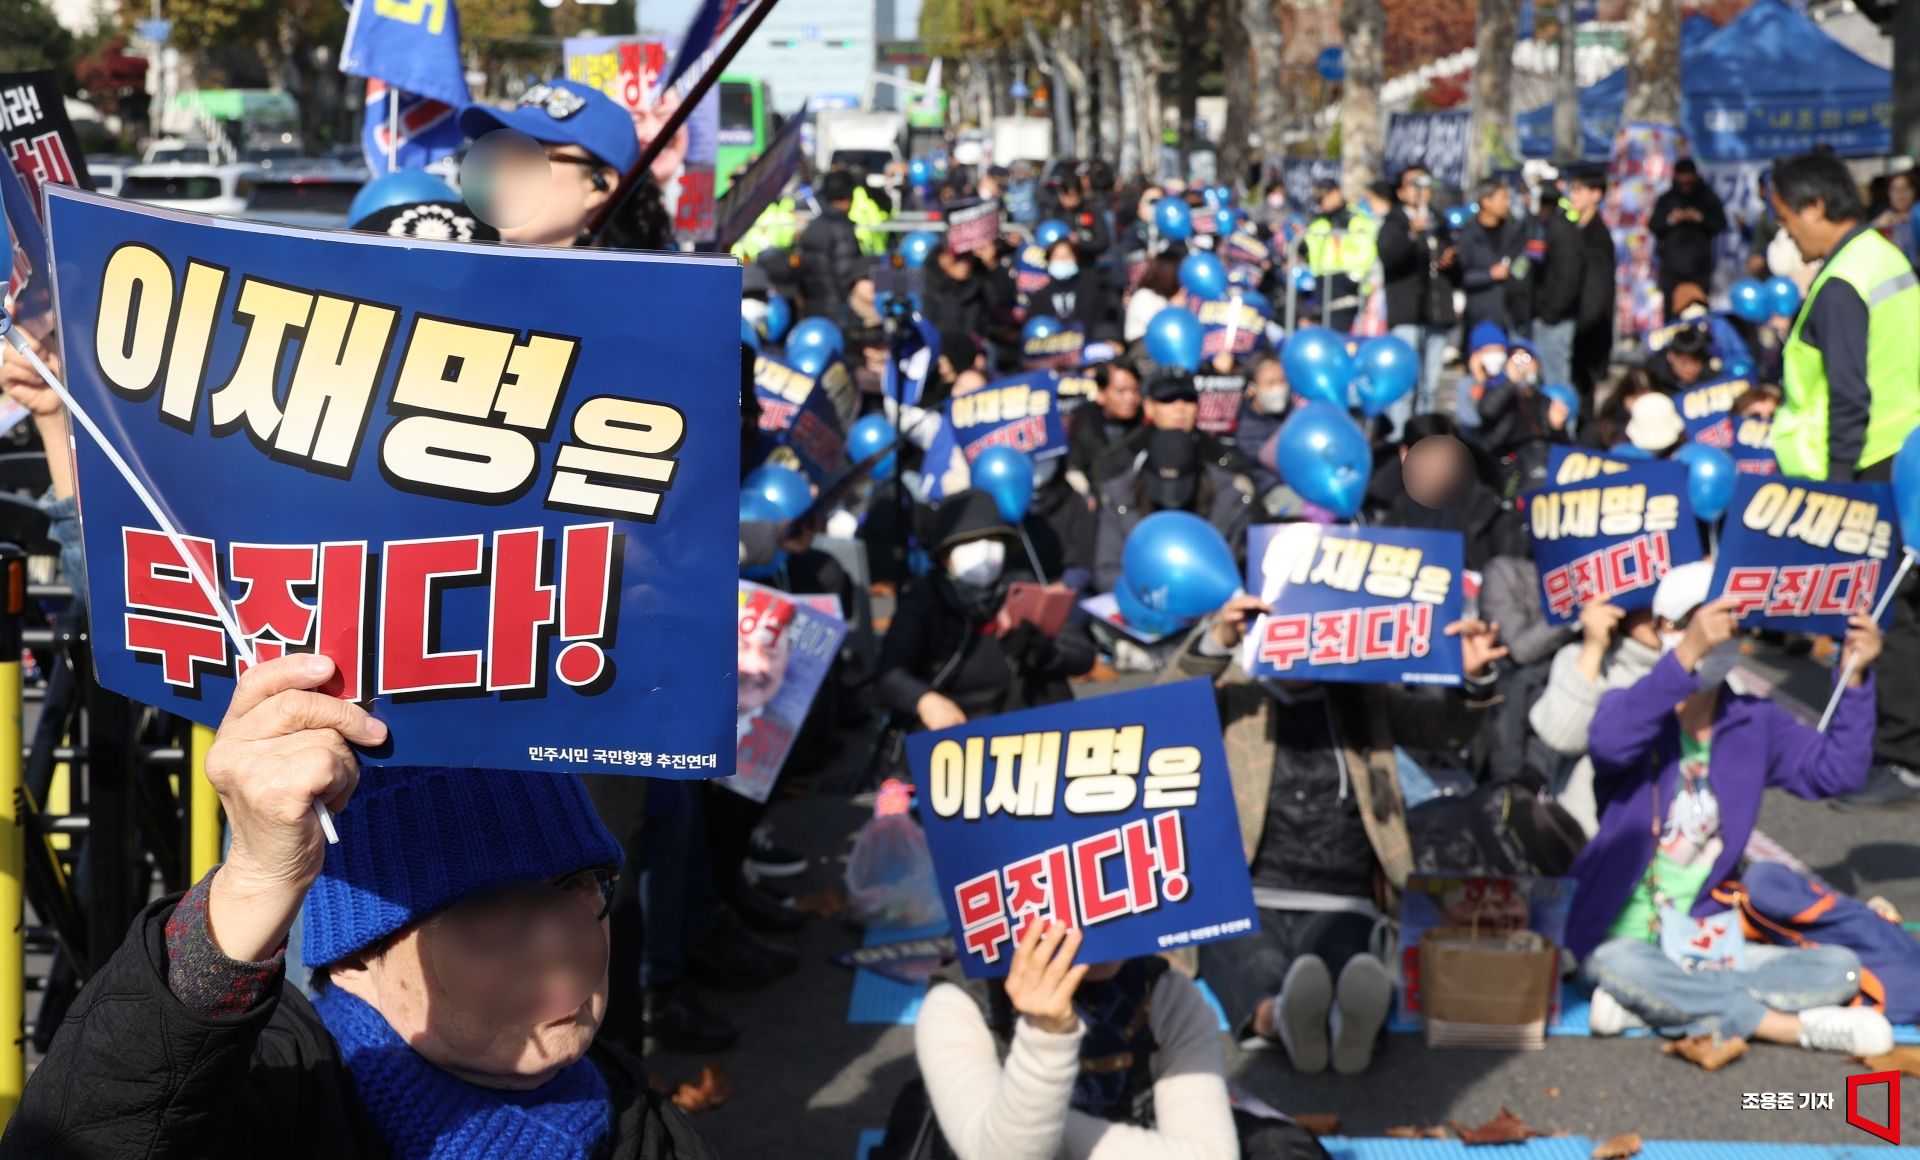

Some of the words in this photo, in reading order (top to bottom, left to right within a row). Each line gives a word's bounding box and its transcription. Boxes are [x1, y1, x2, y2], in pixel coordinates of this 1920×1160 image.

[95, 241, 686, 520] 이재명은
[1531, 483, 1680, 540] 이재명은
[1742, 482, 1893, 560] 이재명은
[121, 520, 616, 703] 무죄다!
[1543, 530, 1673, 619] 무죄다!
[1721, 558, 1882, 620] 무죄다!
[1258, 601, 1434, 671] 무죄다!
[528, 746, 588, 763] 민주시민
[592, 749, 653, 767] 국민항쟁
[656, 754, 717, 769] 추진연대
[930, 725, 1202, 820] 이재명은
[955, 808, 1189, 964] 무죄다!
